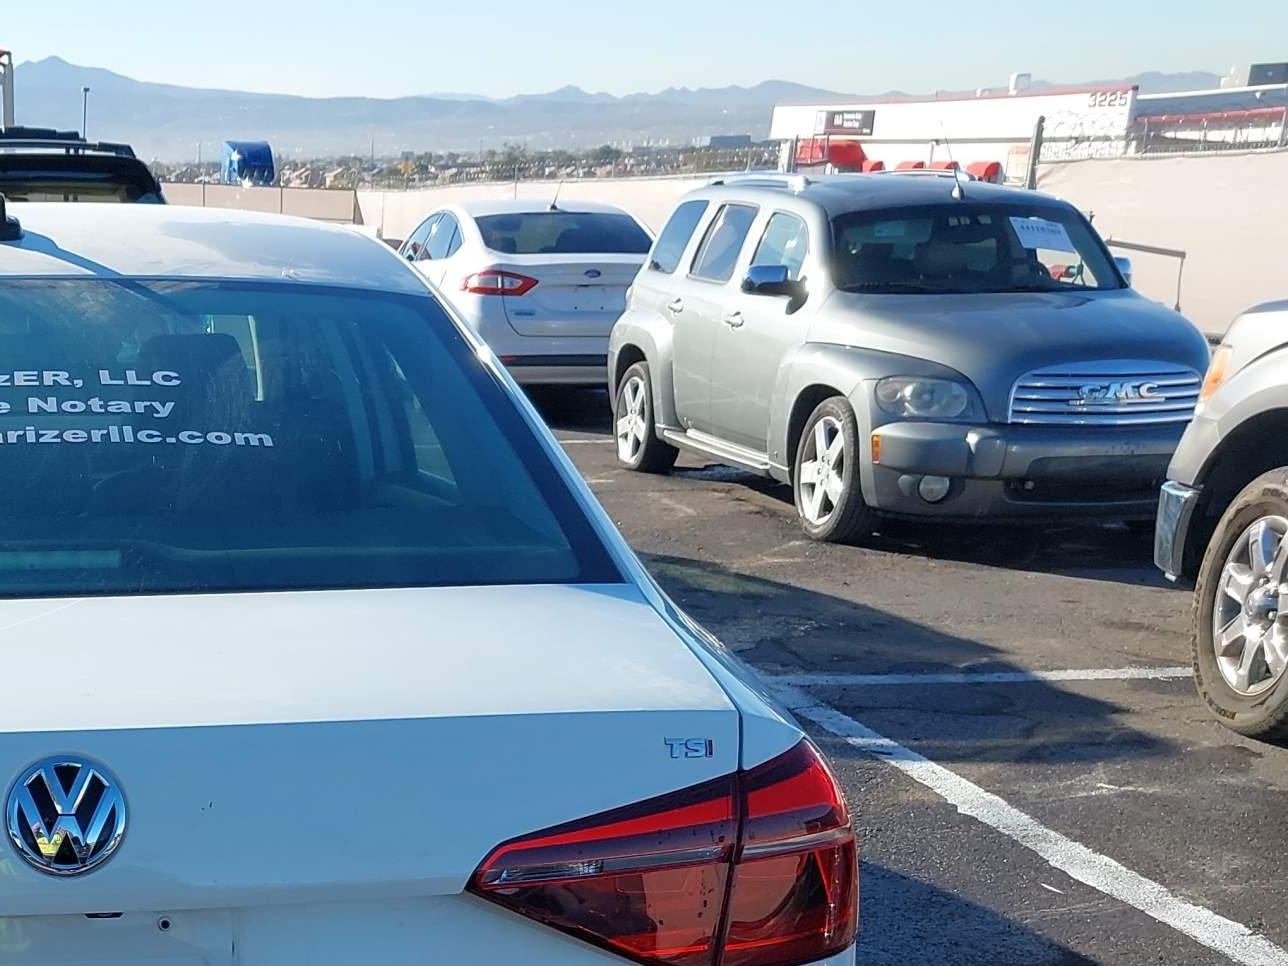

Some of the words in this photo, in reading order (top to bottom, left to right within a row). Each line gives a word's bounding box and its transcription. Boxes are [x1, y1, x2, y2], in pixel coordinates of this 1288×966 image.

[1088, 91, 1128, 107] 3225
[98, 369, 182, 387] LLC
[1079, 382, 1160, 400] GMC
[27, 396, 175, 418] Notary
[663, 736, 713, 758] TSI
[9, 757, 122, 872] VW
